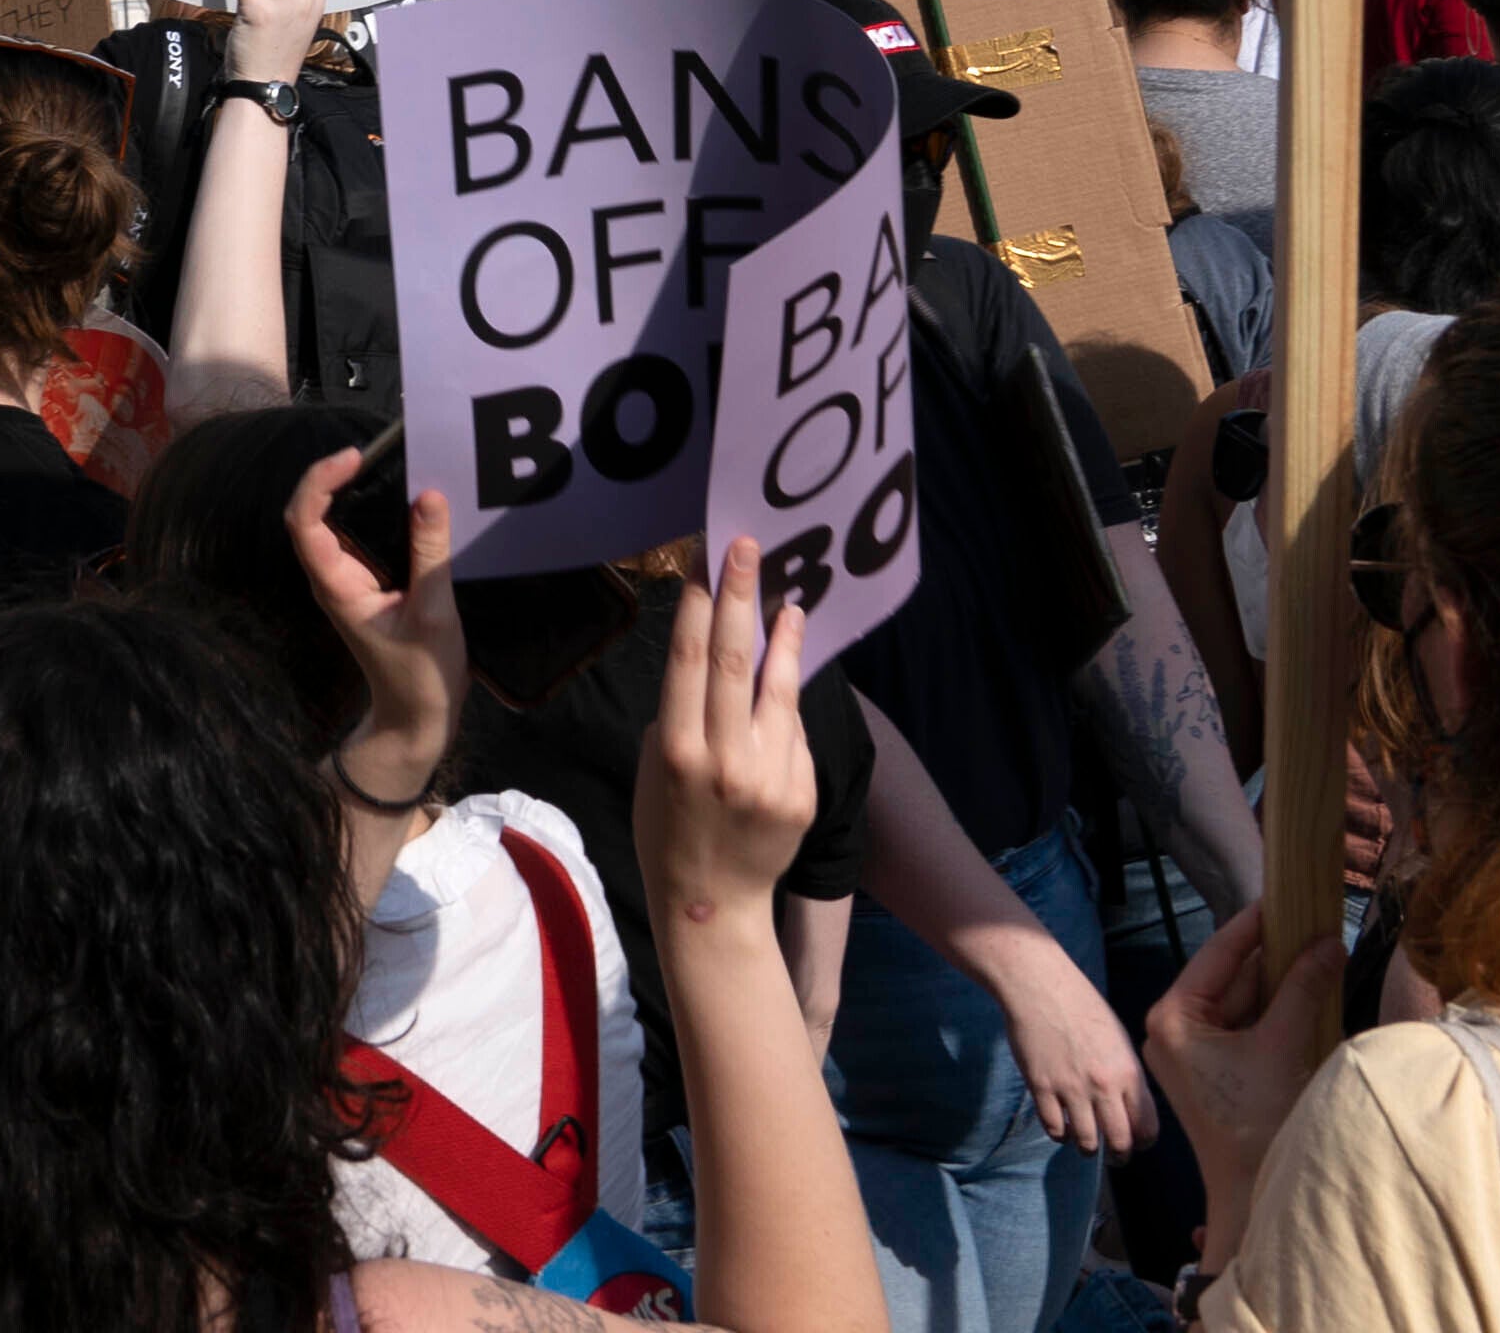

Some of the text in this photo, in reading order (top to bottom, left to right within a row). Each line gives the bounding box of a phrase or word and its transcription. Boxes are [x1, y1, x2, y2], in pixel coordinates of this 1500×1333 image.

[166, 31, 183, 89] SONY
[447, 49, 864, 197] BANS
[461, 196, 766, 350] OFF
[470, 343, 722, 511] BO
